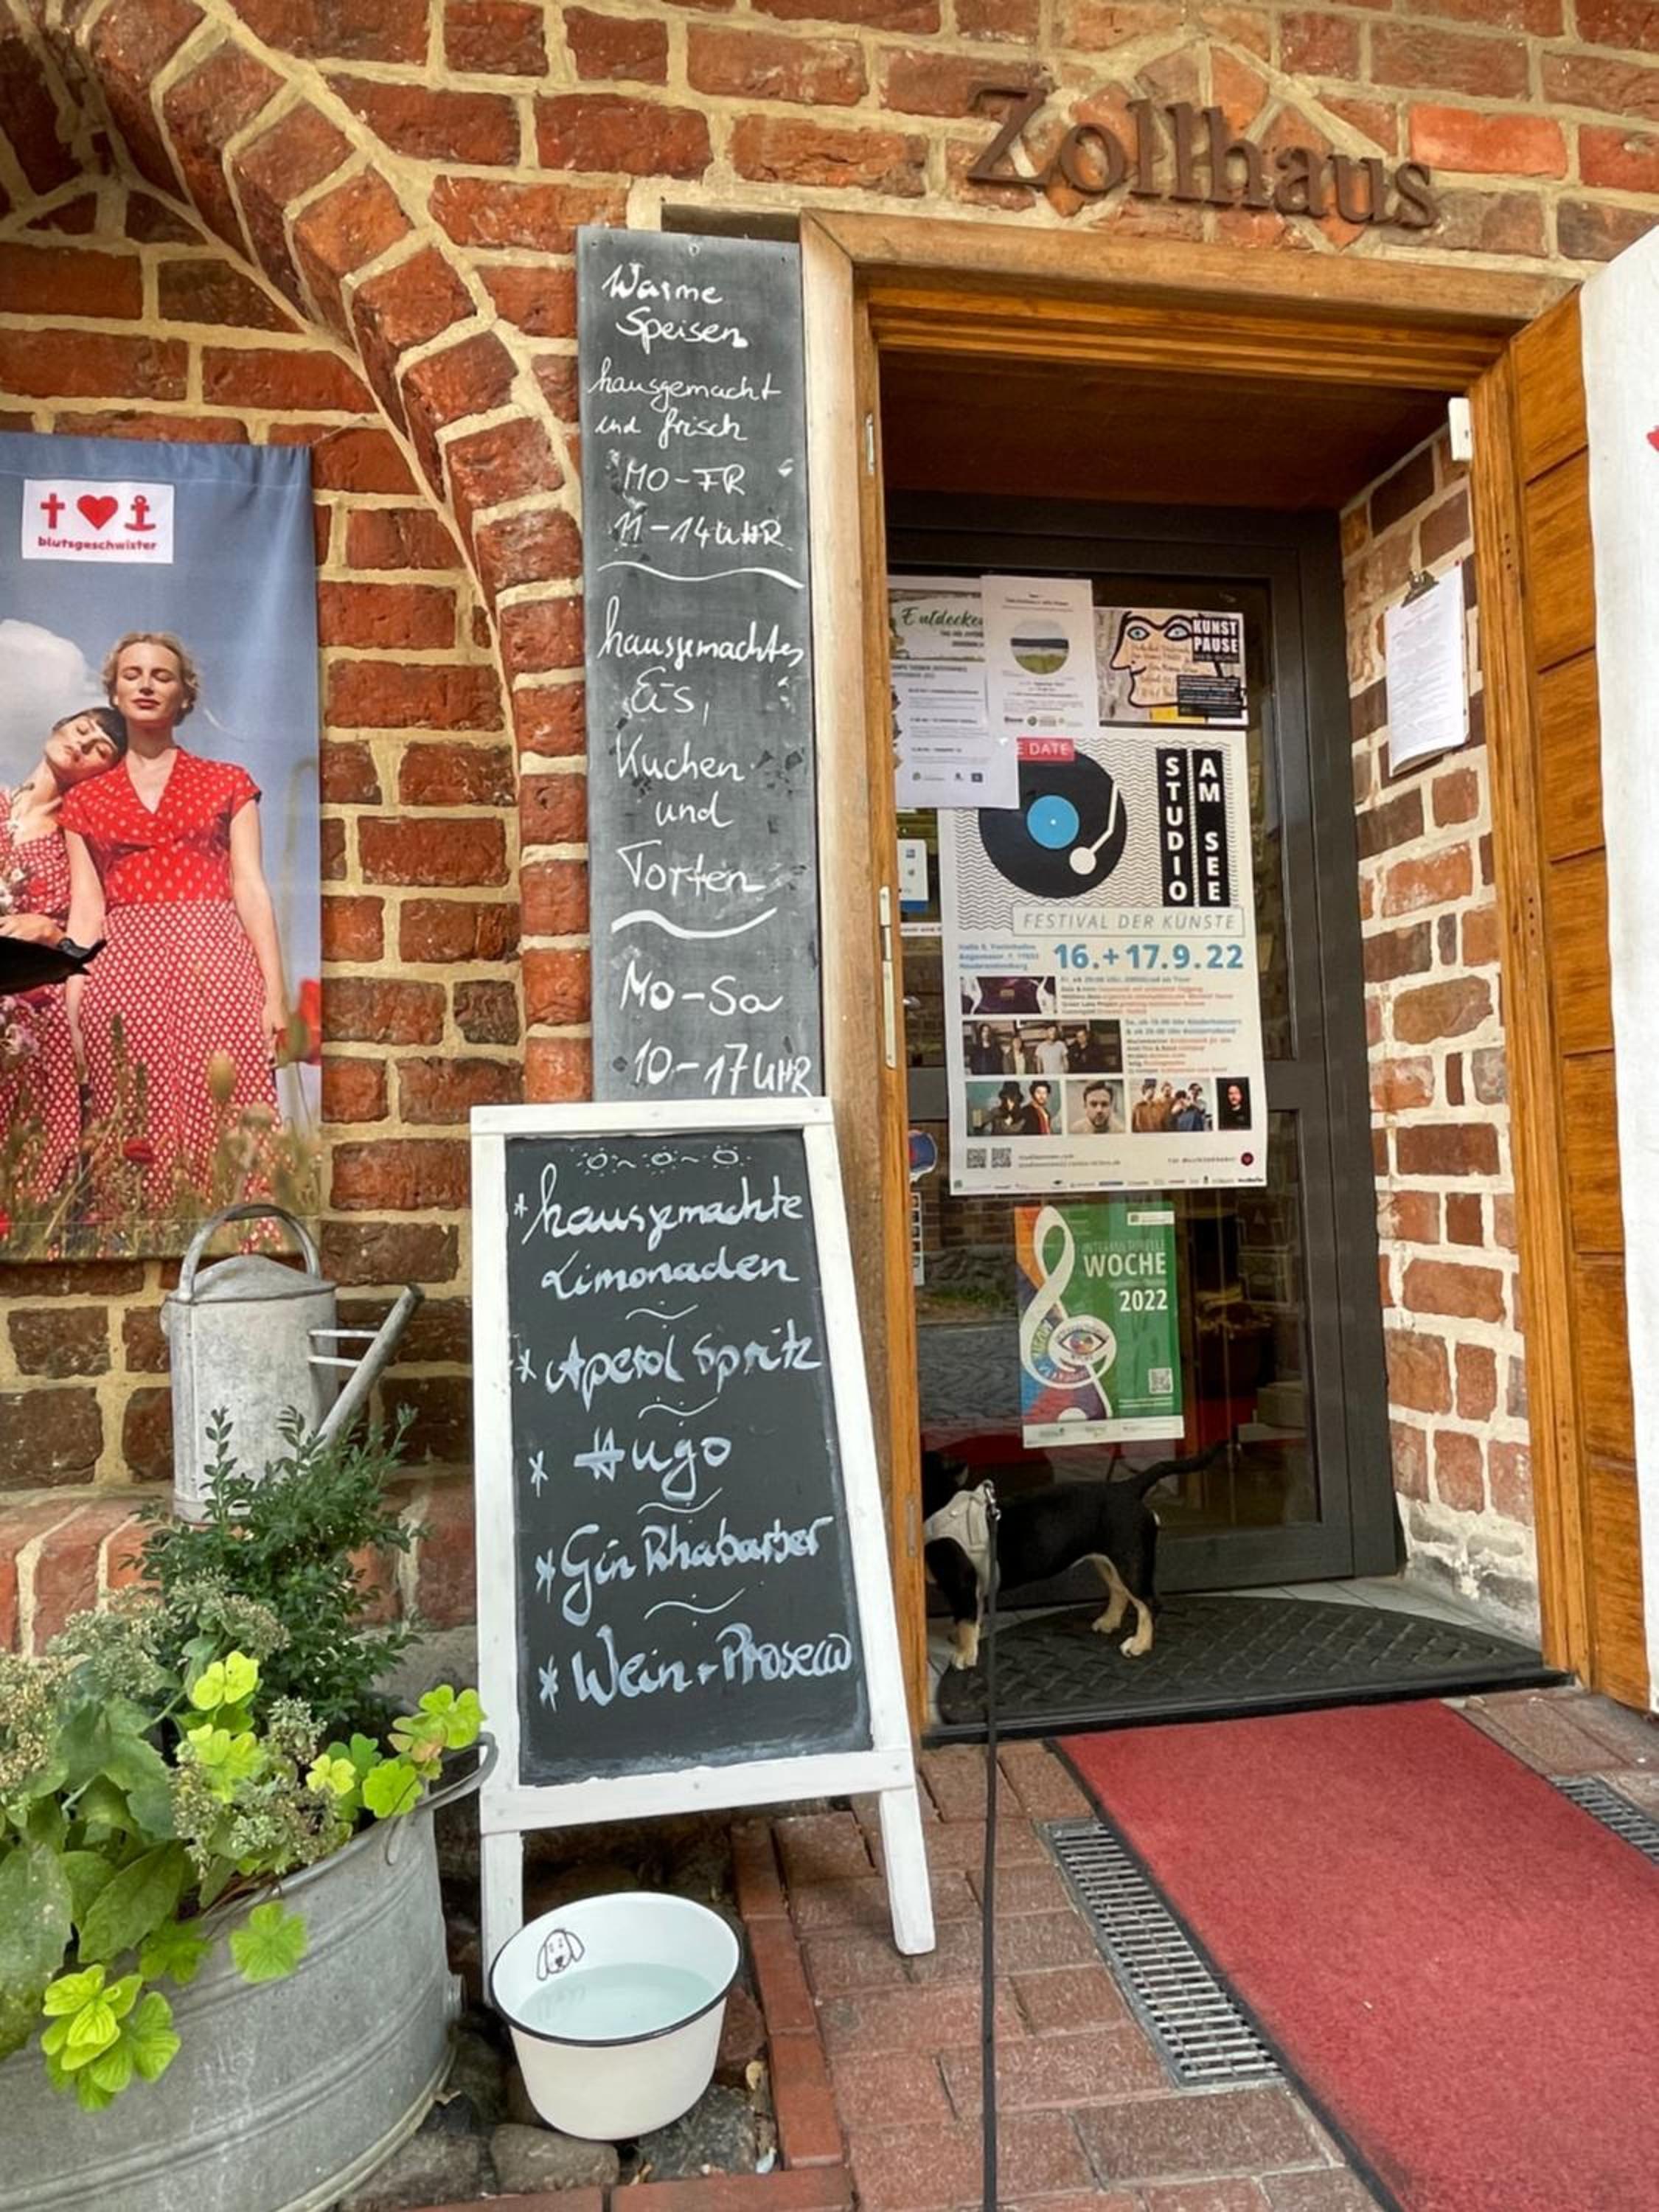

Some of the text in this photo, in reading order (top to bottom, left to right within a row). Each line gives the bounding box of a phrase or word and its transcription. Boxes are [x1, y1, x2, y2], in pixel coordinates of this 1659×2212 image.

[967, 80, 1440, 229] Zollhaus
[602, 262, 723, 303] Warme
[616, 307, 748, 354] Speisen
[589, 356, 782, 411] hausgemacht
[595, 408, 748, 448] und frisch
[38, 536, 157, 552] blutsgeschwister
[597, 596, 804, 670] hausgemachtes
[1193, 619, 1238, 636] KUNST
[1194, 636, 1239, 653] PAUSE
[616, 733, 745, 782] Kuchen
[1029, 742, 1068, 756] DATE
[655, 790, 735, 828] und
[1165, 756, 1188, 901] STUDIO
[1198, 757, 1222, 902] AM SEE
[616, 839, 767, 897] Torten
[1023, 913, 1108, 929] FESTIVAL
[1118, 913, 1154, 930] DER
[522, 1163, 804, 1251] hausgemachte
[541, 1245, 800, 1300] Limonaden
[1083, 1252, 1167, 1279] WOCHE
[1119, 1288, 1169, 1312] 2022
[546, 1318, 822, 1413] Aperol Spritz
[574, 1427, 732, 1502] Hugo
[561, 1517, 835, 1627] Gin Rhabarber
[571, 1625, 692, 1707] Wein
